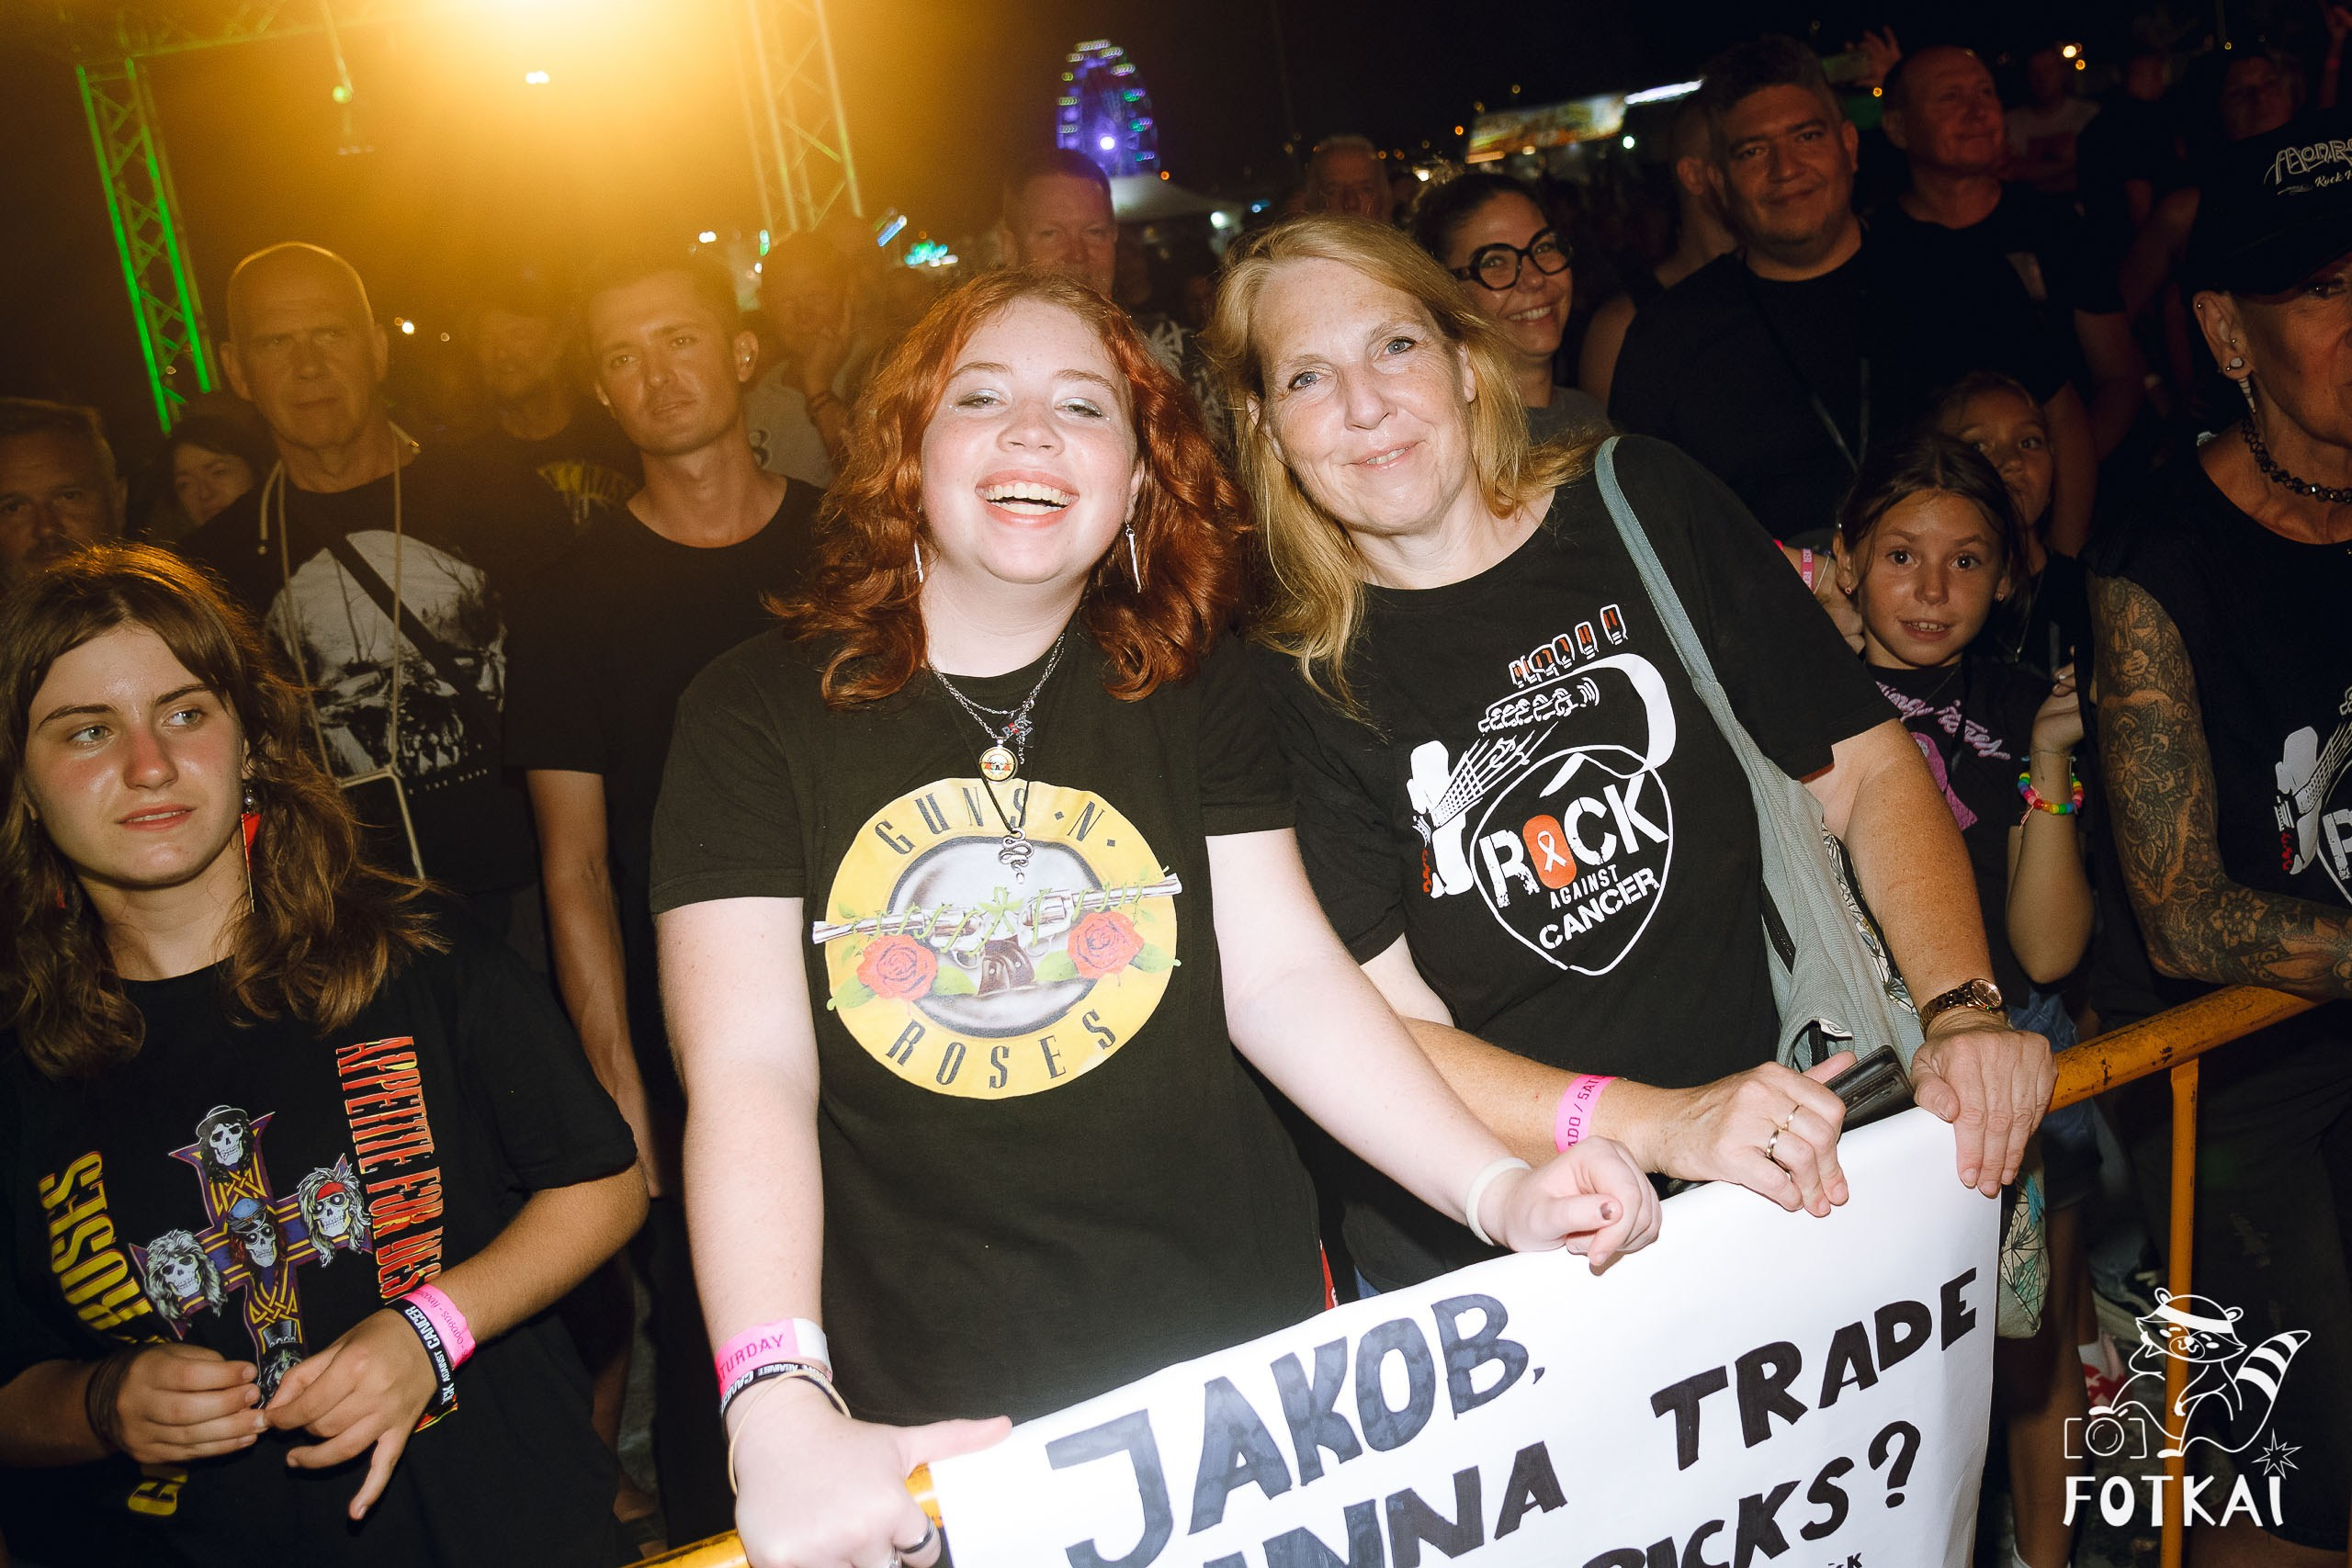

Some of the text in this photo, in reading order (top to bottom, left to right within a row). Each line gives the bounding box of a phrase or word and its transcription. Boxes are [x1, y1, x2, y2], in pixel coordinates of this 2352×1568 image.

[875, 786, 1028, 855] GUNS
[1479, 773, 1669, 908] ROCK
[1539, 867, 1660, 950] CANCER
[1550, 864, 1621, 909] AGAINST
[886, 1009, 1116, 1089] ROSES
[335, 1036, 444, 1299] APPETITE FOR DES
[1567, 1116, 1581, 1147] ADO
[39, 1151, 153, 1331] ROSES
[404, 1305, 441, 1350] CANCER
[434, 1350, 451, 1382] AGAINST
[719, 1333, 785, 1380] TURDAY
[1046, 1293, 1545, 1568] JAKOB,
[1204, 1267, 1979, 1568] NNA TRADE
[1581, 1420, 1922, 1568] CKS?
